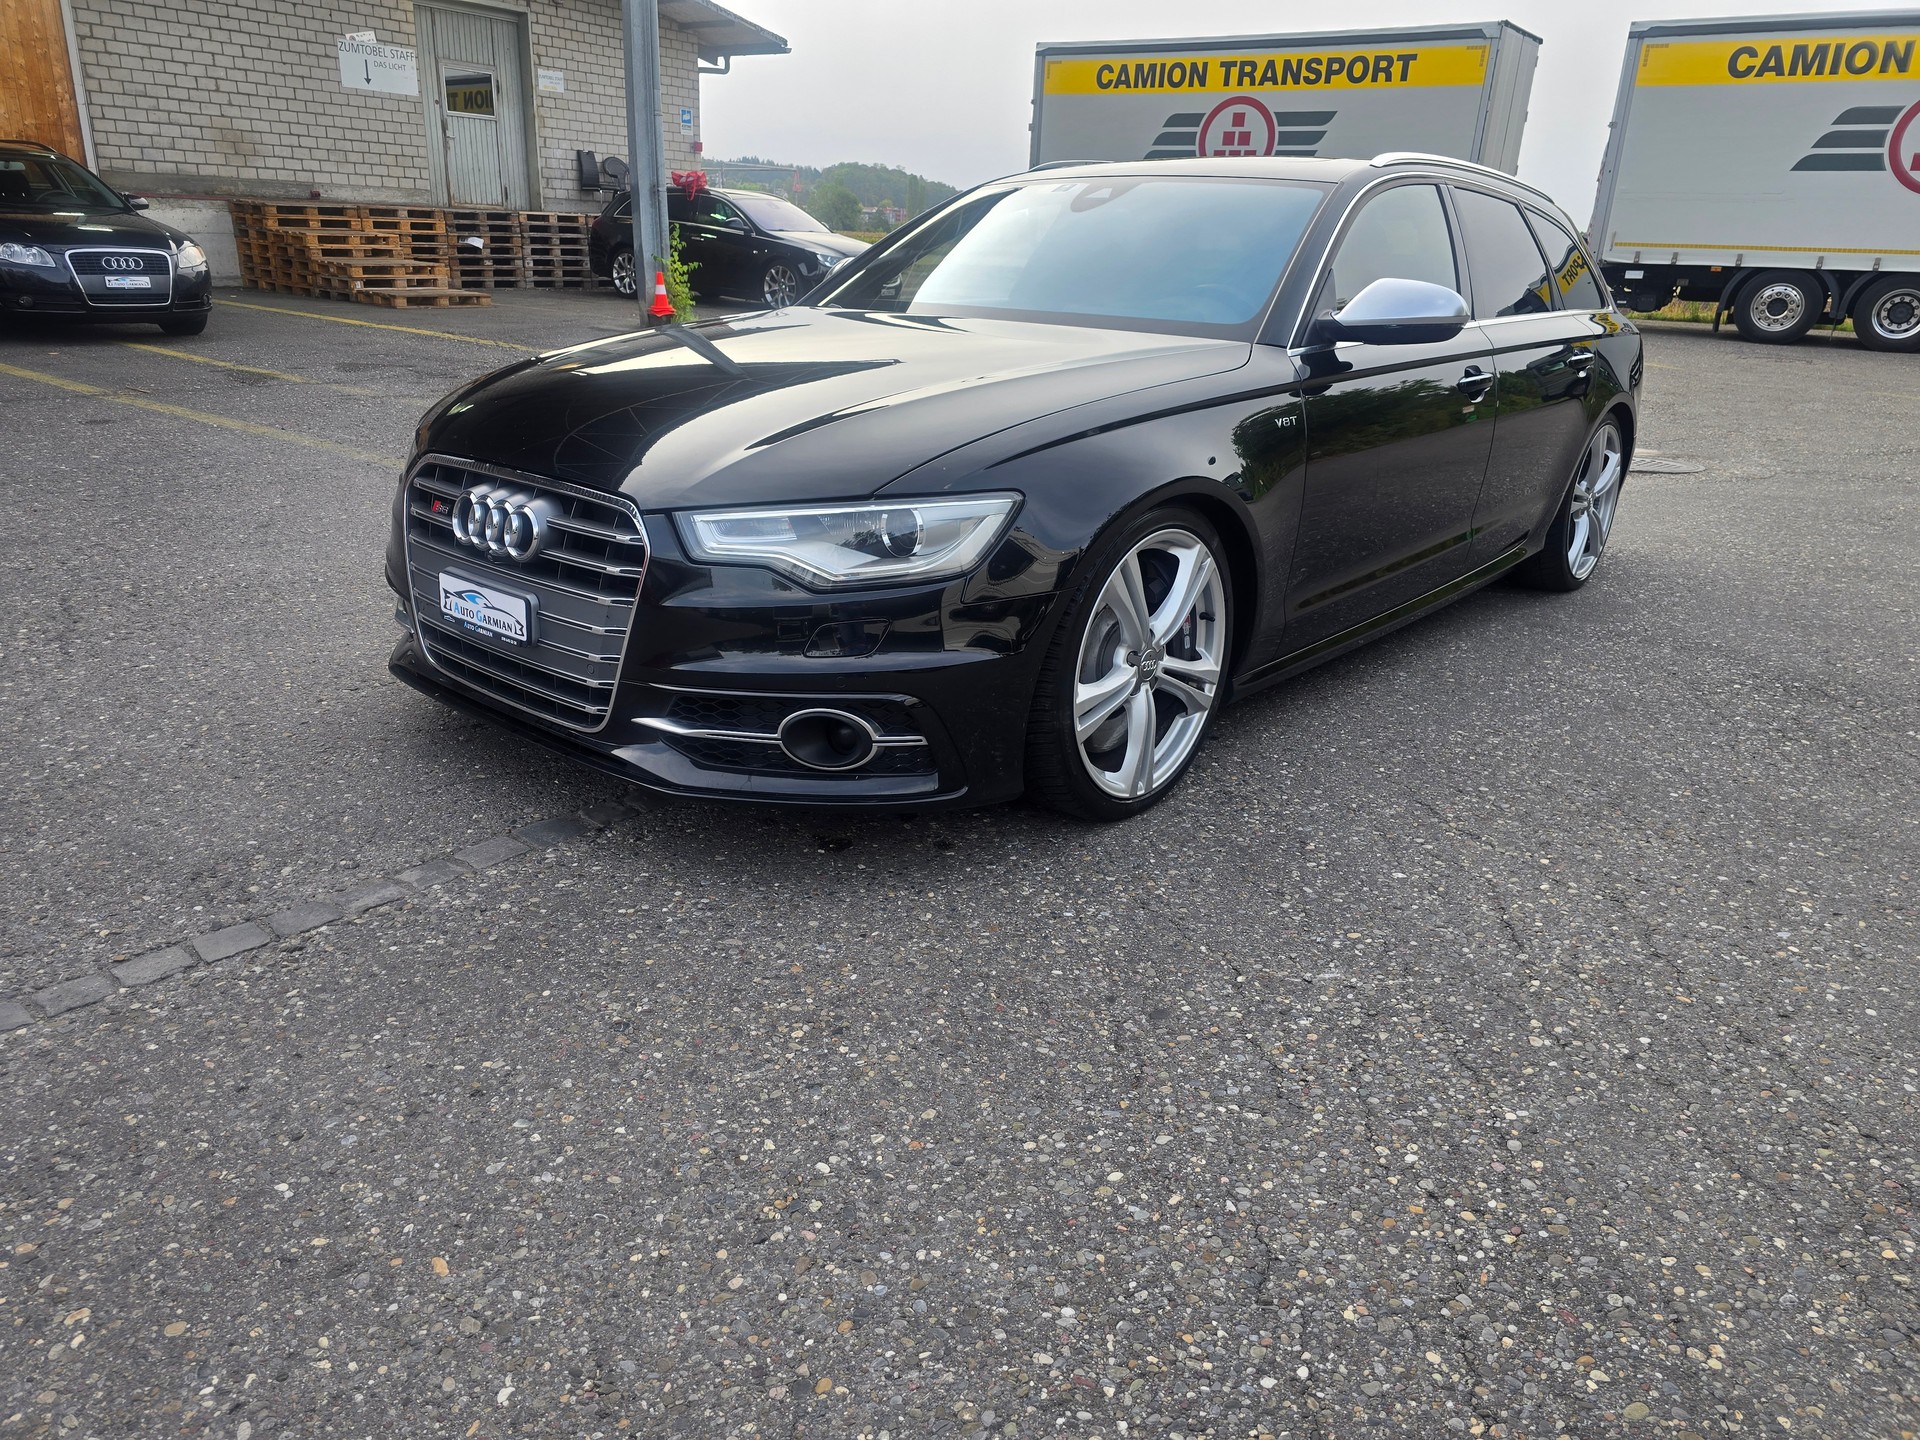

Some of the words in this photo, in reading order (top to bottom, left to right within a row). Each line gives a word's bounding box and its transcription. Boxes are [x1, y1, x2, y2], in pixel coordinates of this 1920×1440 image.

[338, 40, 389, 58] ZUMTOBEL
[390, 48, 416, 62] STAFF
[1727, 39, 1917, 79] CAMION
[373, 60, 387, 69] DAS
[388, 62, 406, 72] LICHT
[1095, 60, 1209, 90] CAMION
[1219, 53, 1418, 88] TRANSPORT
[1274, 415, 1297, 428] V8T
[453, 601, 475, 619] AUTO
[475, 609, 513, 633] GARMIAN
